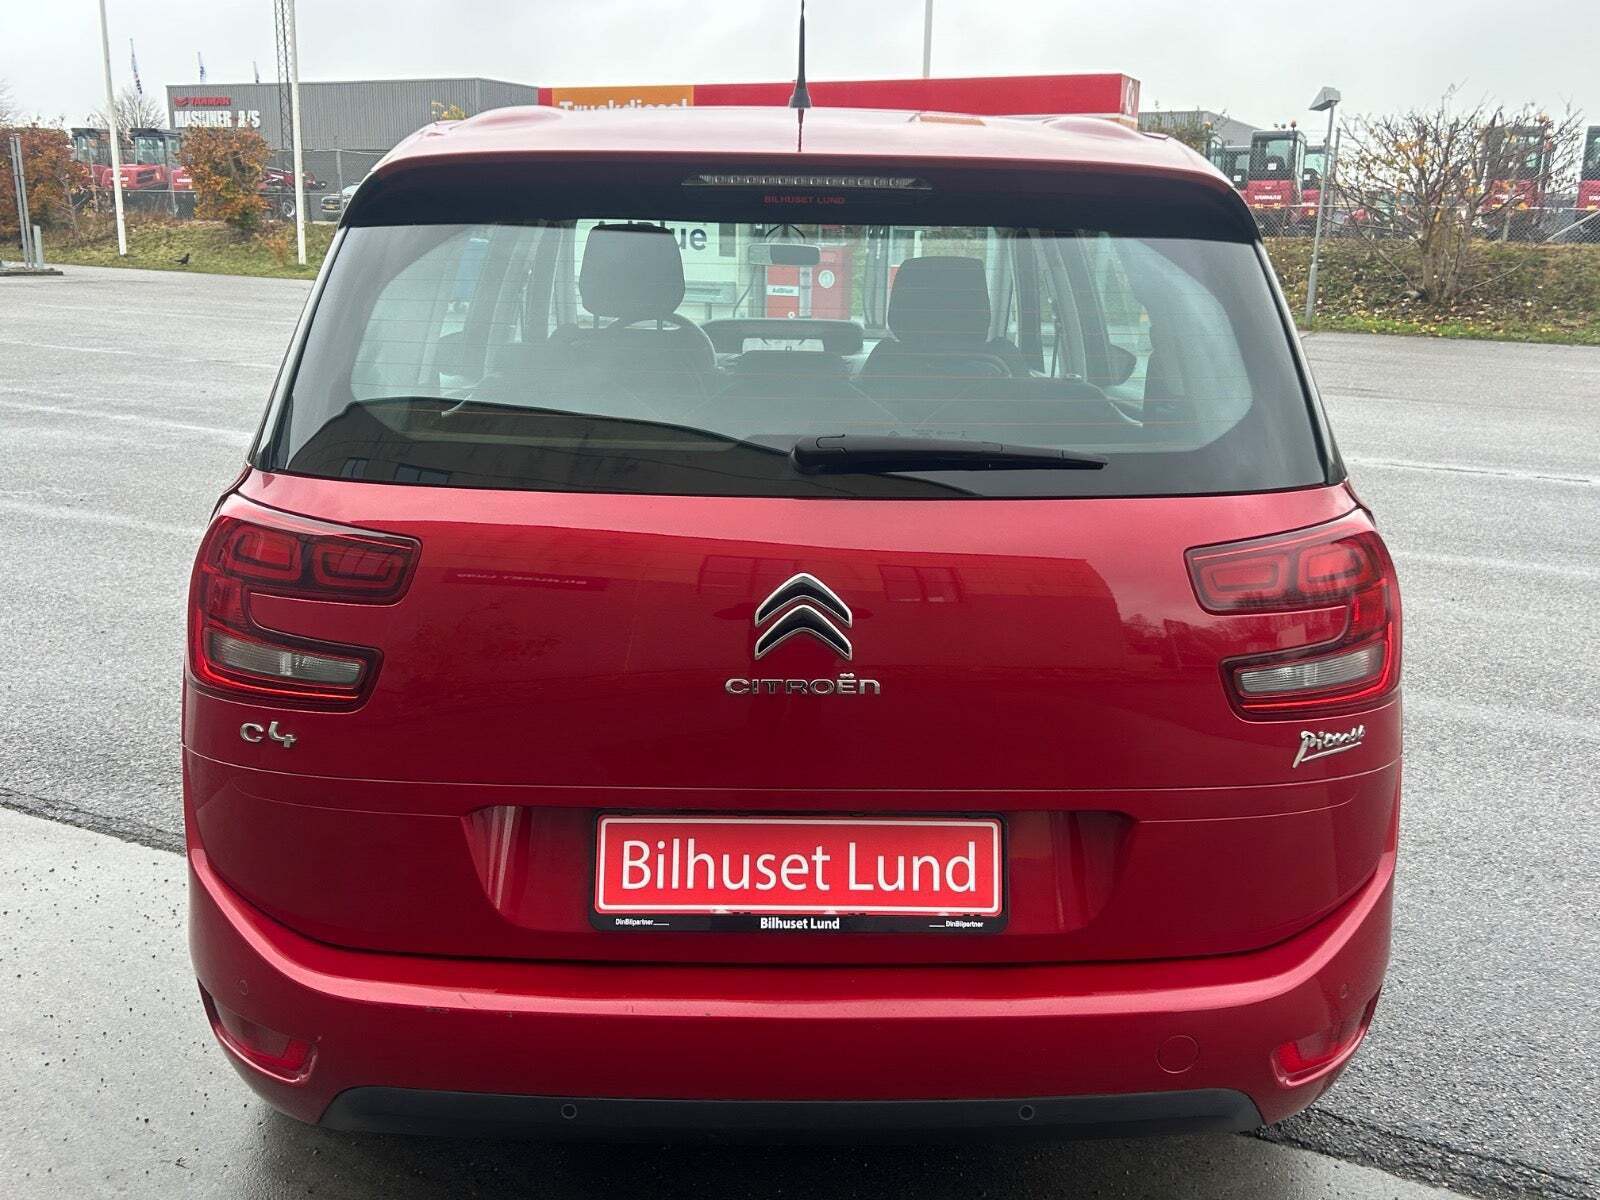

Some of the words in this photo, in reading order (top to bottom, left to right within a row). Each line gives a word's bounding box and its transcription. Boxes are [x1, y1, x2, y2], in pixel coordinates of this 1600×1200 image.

[763, 195, 814, 204] BILHUSET
[817, 195, 846, 204] LUND
[240, 721, 297, 748] C4
[620, 838, 831, 890] Bilhuset
[848, 841, 977, 893] Lund
[760, 916, 808, 929] Bilhuset
[810, 917, 840, 929] Lund
